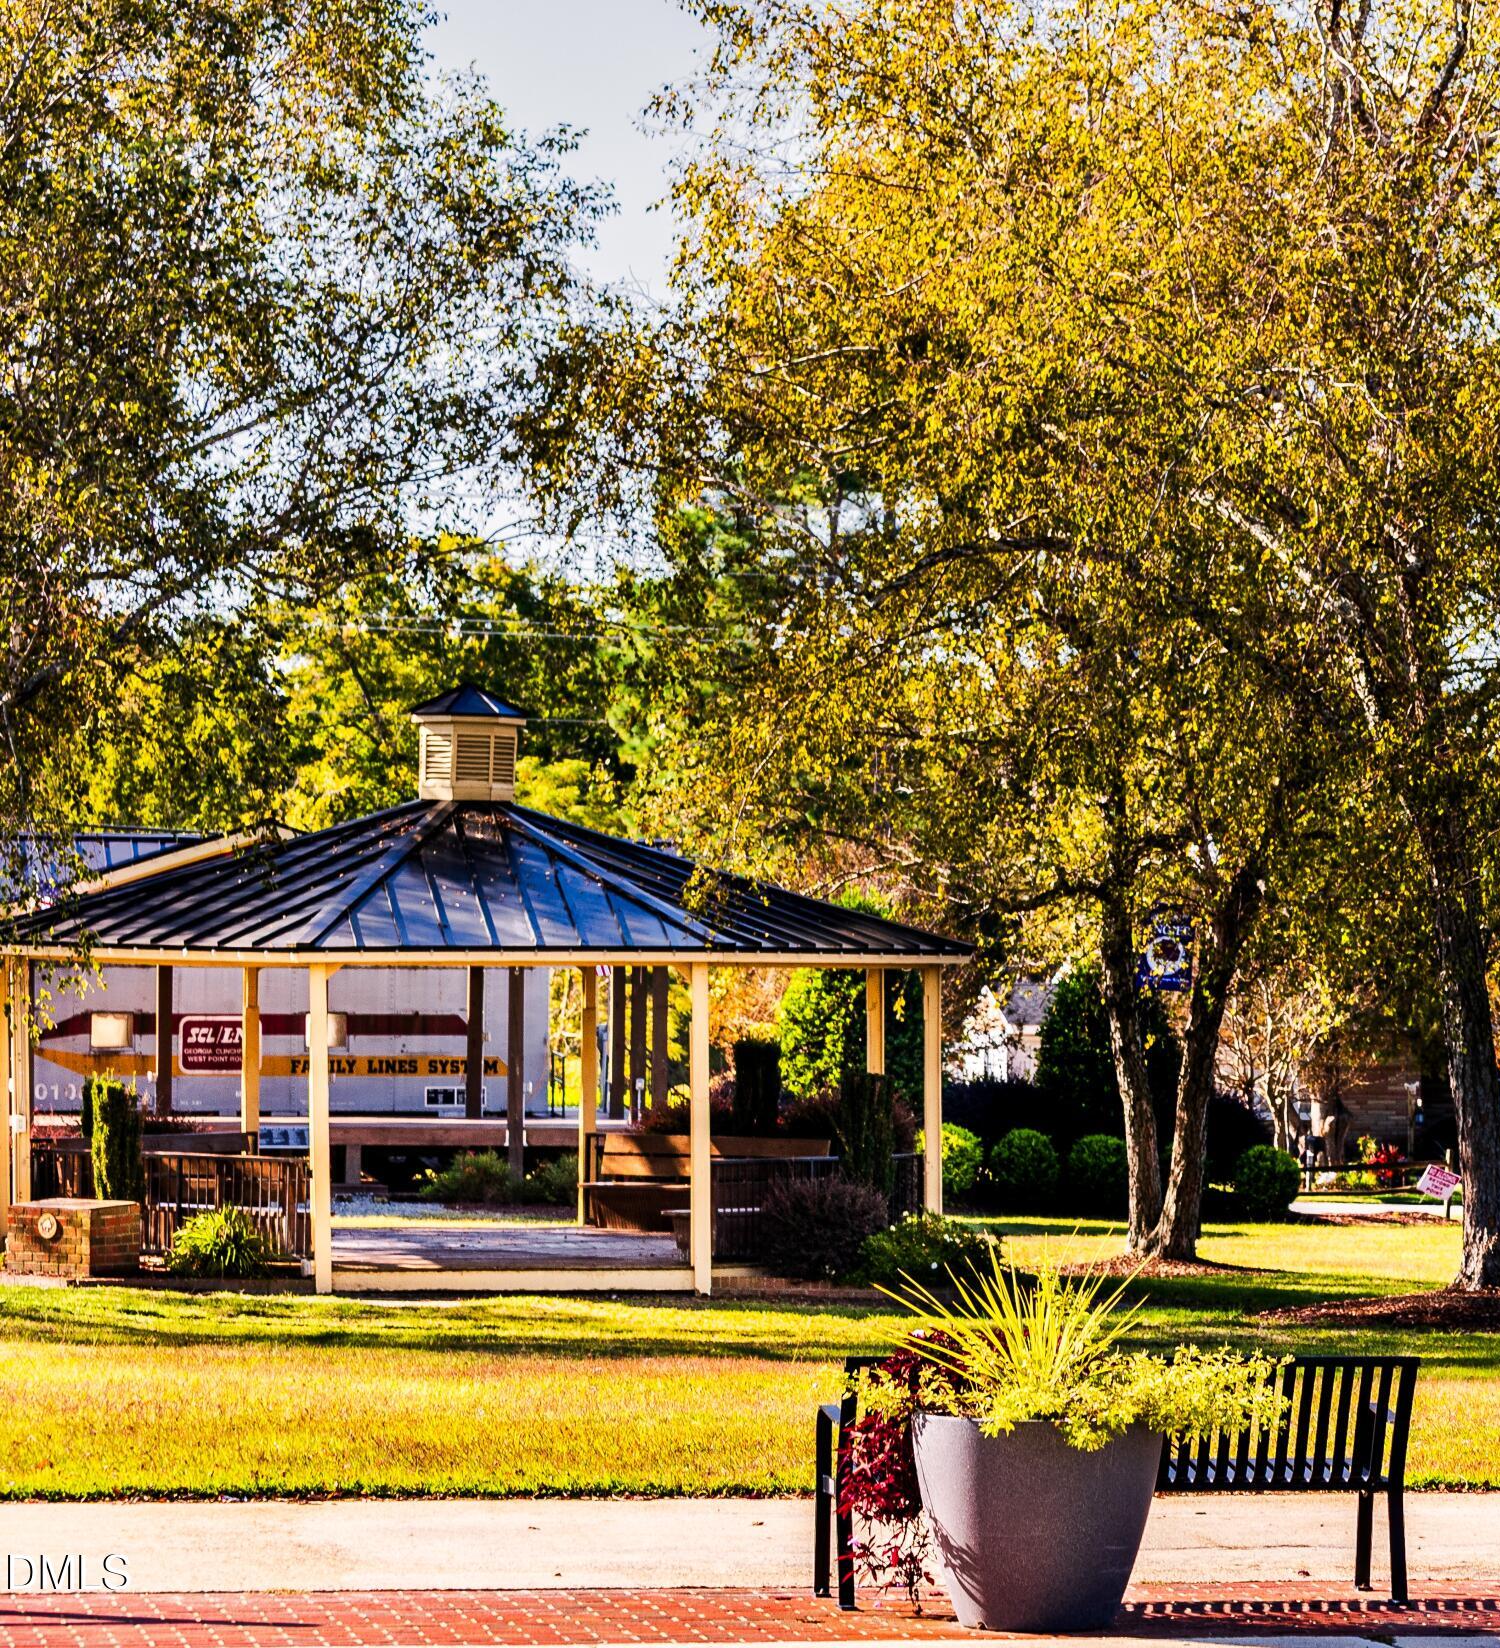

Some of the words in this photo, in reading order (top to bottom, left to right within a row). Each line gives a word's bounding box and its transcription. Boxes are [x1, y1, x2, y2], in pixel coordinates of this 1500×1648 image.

[291, 1059, 356, 1074] FAILY
[367, 1059, 418, 1074] LINES
[428, 1059, 498, 1074] SYSTM
